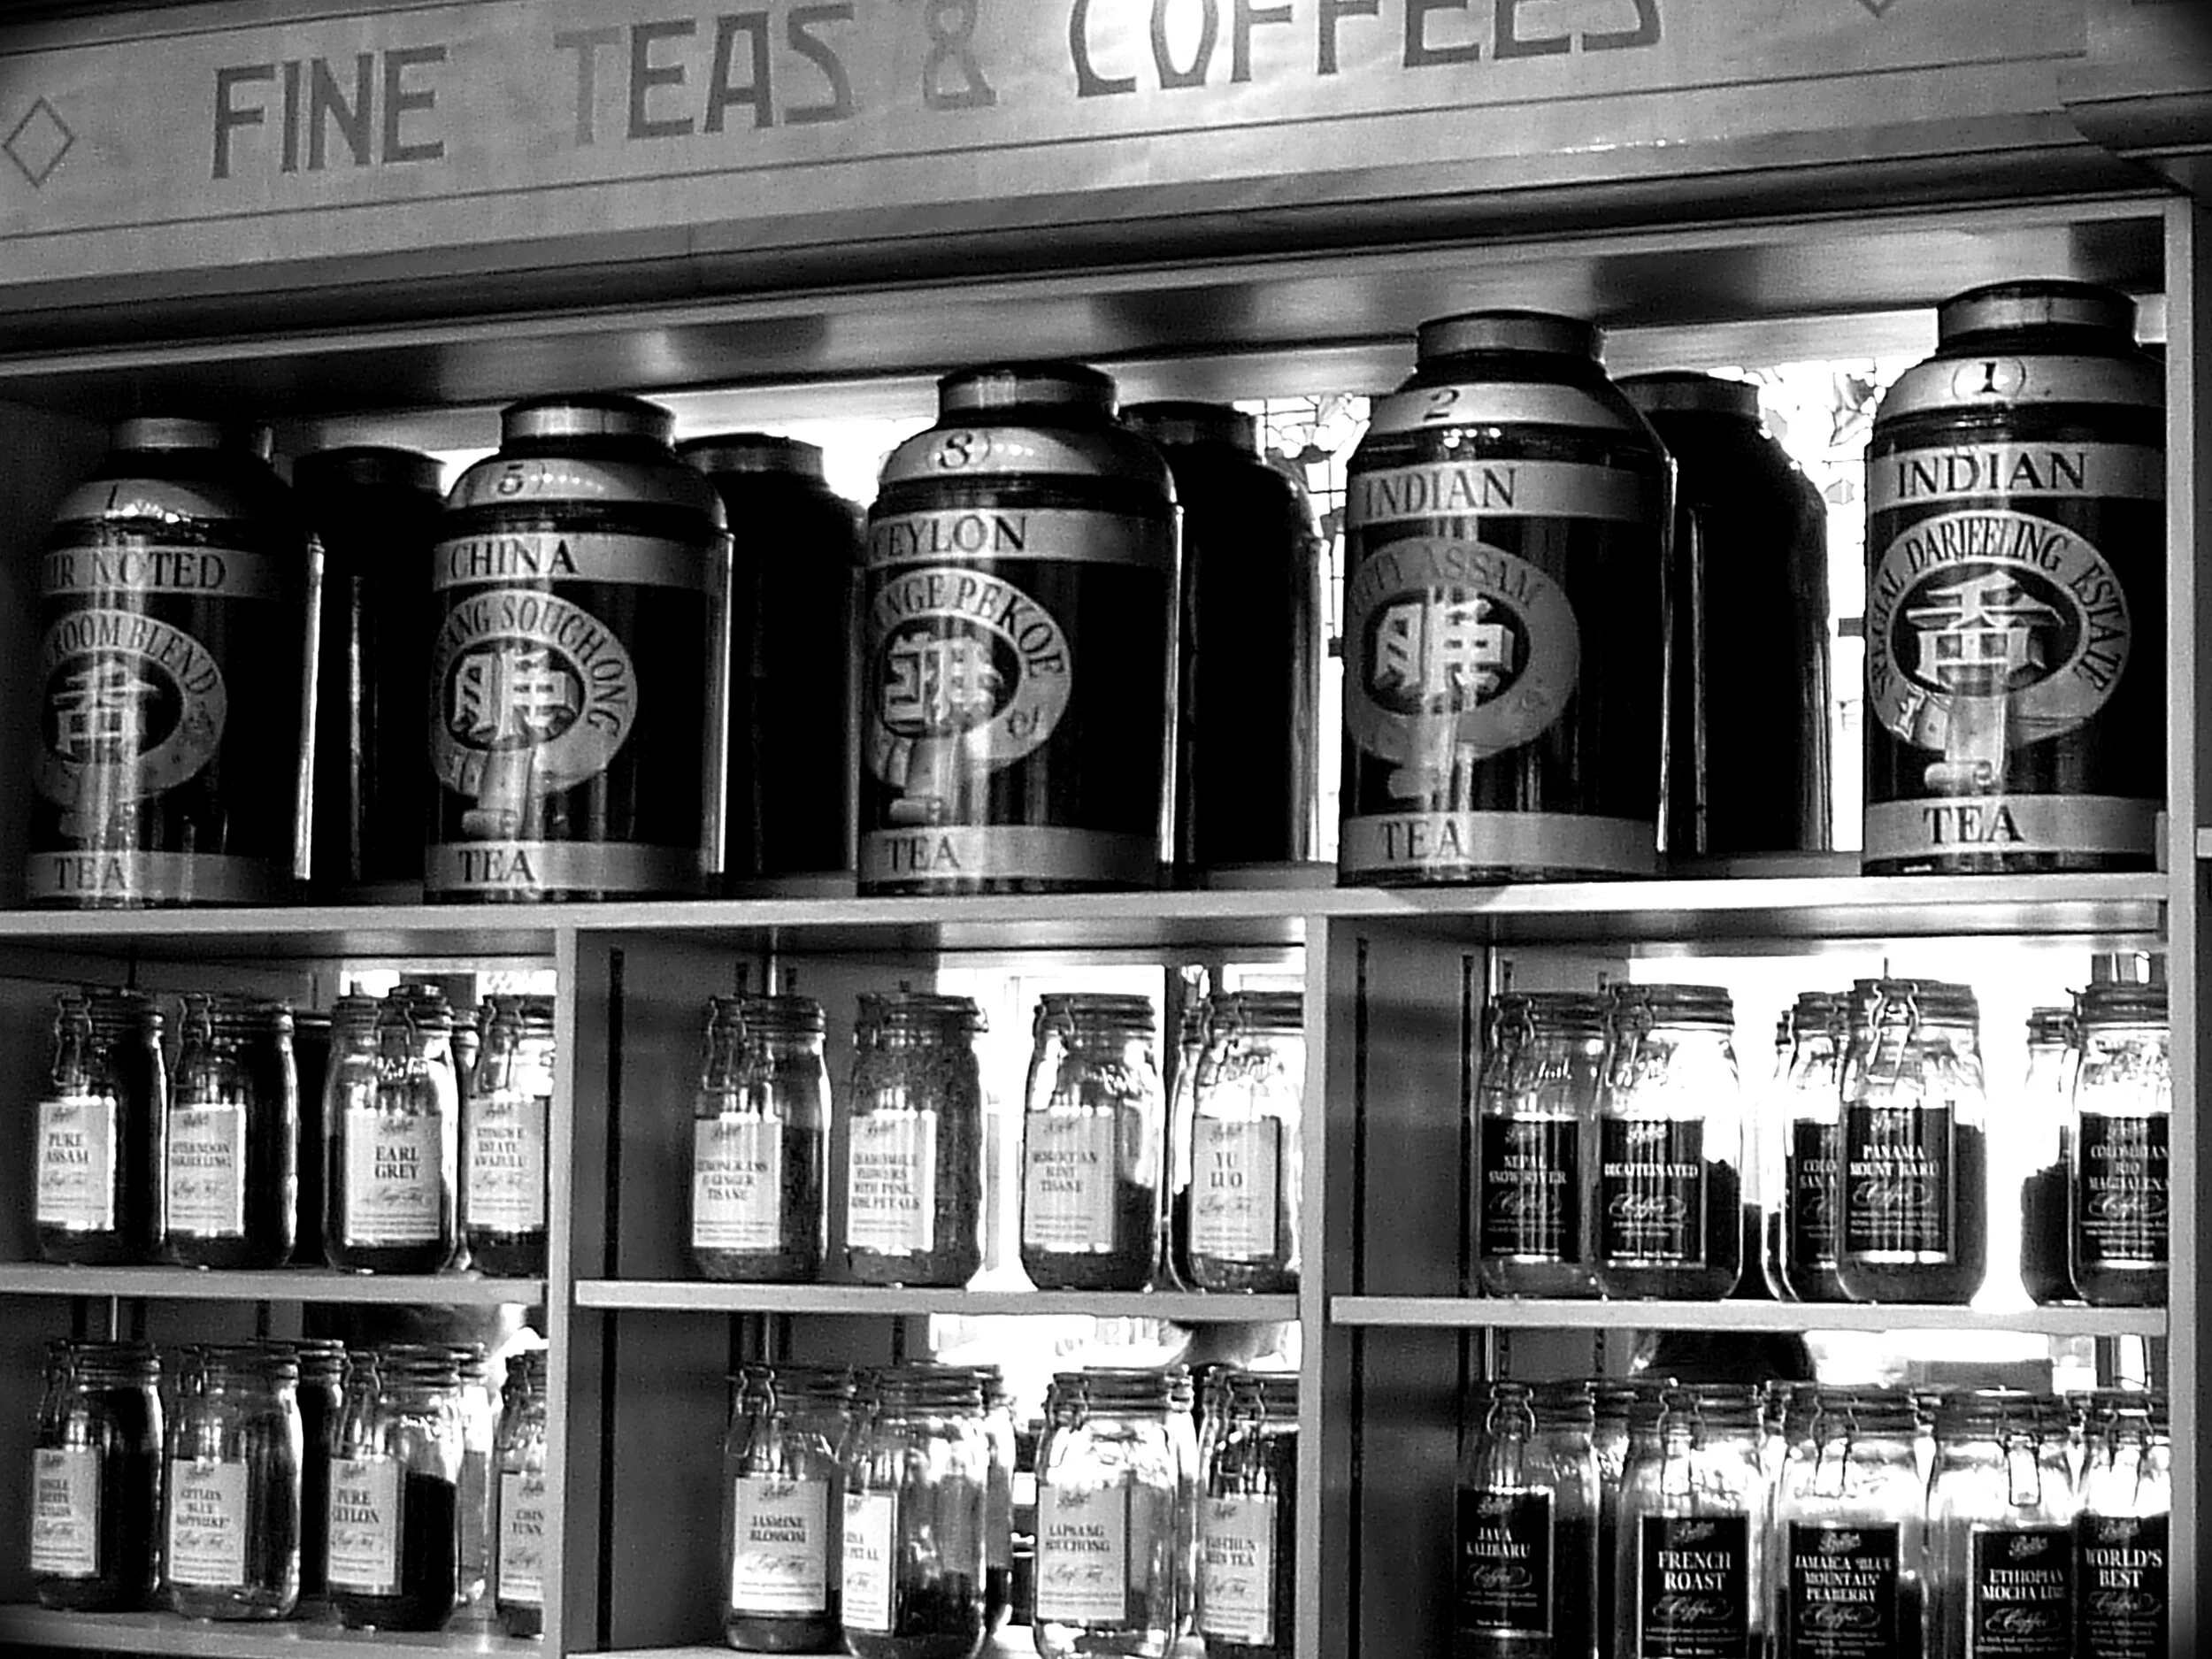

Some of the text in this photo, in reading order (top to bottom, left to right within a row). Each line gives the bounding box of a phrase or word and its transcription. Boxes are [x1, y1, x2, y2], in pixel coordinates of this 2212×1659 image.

[212, 45, 449, 178] FINE
[555, 4, 856, 145] TEAS
[1424, 389, 1459, 420] 2
[497, 464, 525, 495] 5
[1898, 451, 2087, 498] INDIAN
[1365, 467, 1517, 519] INDIAN
[92, 550, 227, 588] NOTED
[450, 539, 580, 579] CHINA
[1905, 515, 2069, 574] DARJEELING
[2069, 561, 2124, 693] ESTATE
[957, 577, 1064, 678] PEKOE
[130, 619, 219, 696] BLEND
[501, 595, 630, 738] SOUCHONG
[1380, 818, 1466, 862] TEA
[1923, 806, 2024, 844] TEA
[458, 850, 536, 884] TEA
[885, 835, 962, 872] TEA
[53, 855, 128, 891] TEA
[375, 1146, 420, 1163] EARL
[374, 1164, 419, 1180] GREY
[751, 1515, 805, 1530] JASMINE
[1478, 1527, 1512, 1543] JAVA
[1657, 1550, 1732, 1571] FRENCH
[1794, 1555, 1853, 1571] JAMAICA
[2085, 1548, 2163, 1569] WORLD'S
[1663, 1571, 1727, 1591] ROAST
[1989, 1568, 2064, 1585] ETHIOPIAN
[2099, 1569, 2145, 1589] BEST
[1806, 1587, 1876, 1602] PEABERRY
[1981, 1585, 2037, 1601] MOCHA
